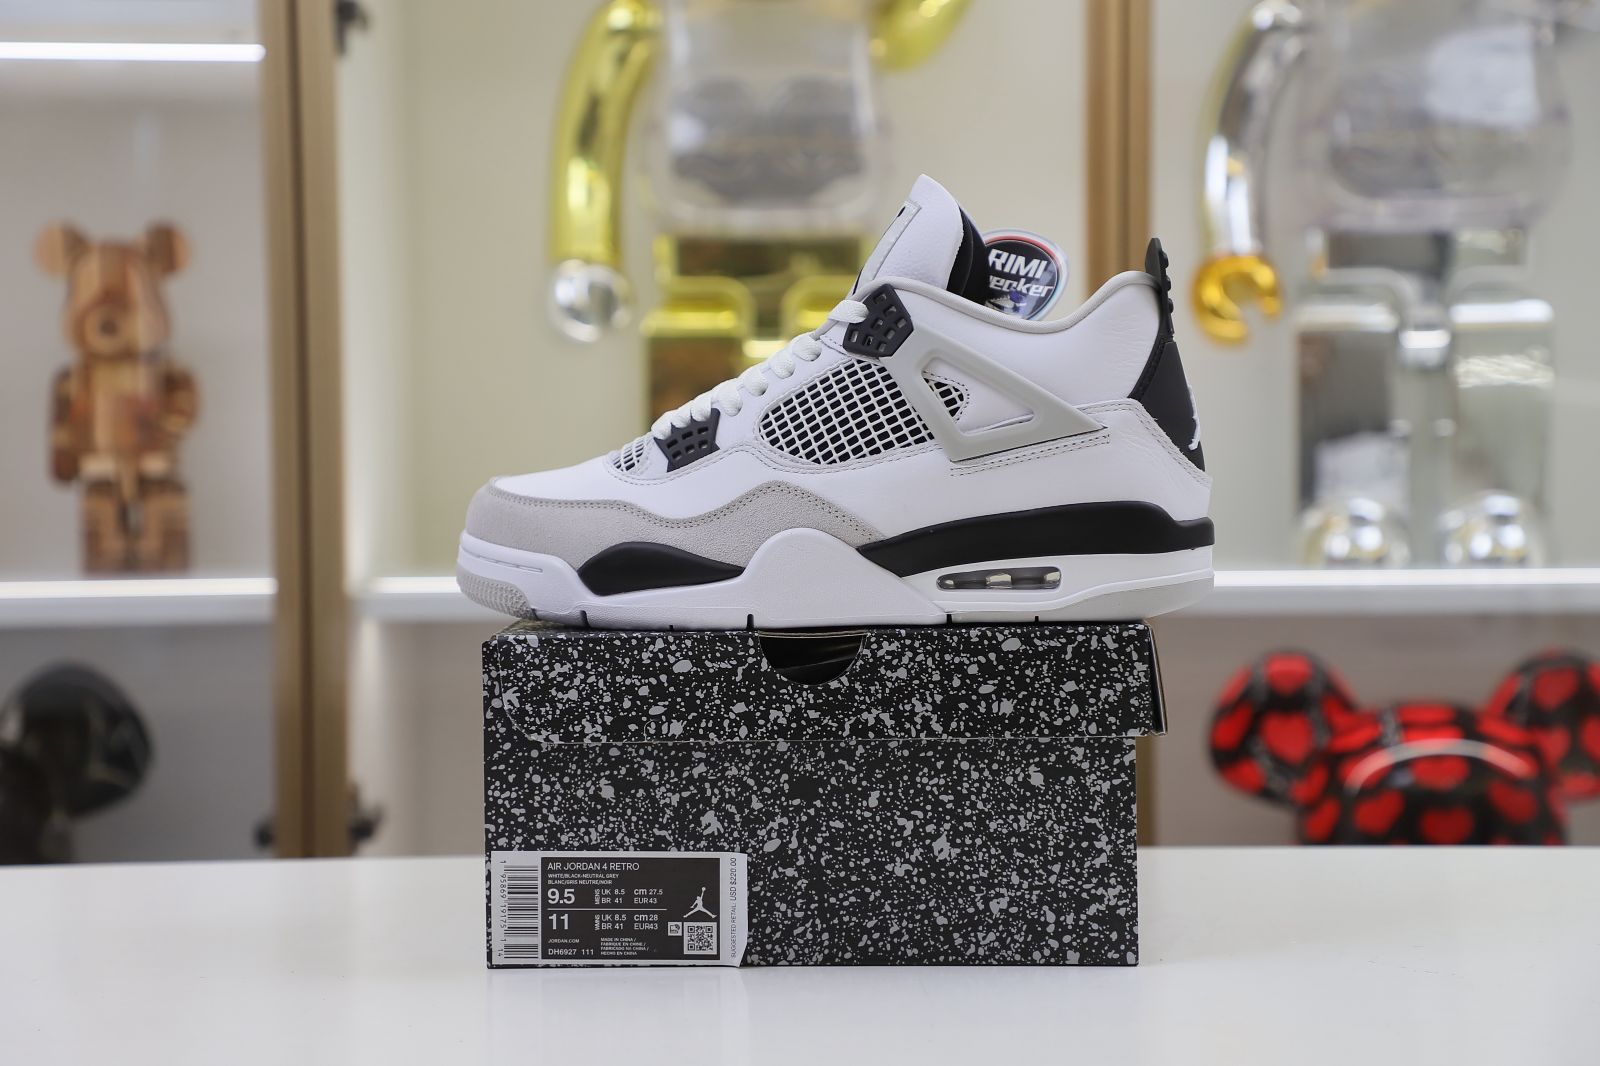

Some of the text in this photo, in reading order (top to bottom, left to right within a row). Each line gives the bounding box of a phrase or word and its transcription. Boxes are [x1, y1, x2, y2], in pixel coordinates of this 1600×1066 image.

[989, 274, 1055, 298] ecker
[547, 862, 640, 871] AIR JORDAN 4 RETRO
[729, 857, 737, 885] $220.00
[499, 874, 507, 899] 95869
[601, 888, 664, 896] UK 8.5 cm 27.5
[729, 886, 737, 901] USD
[547, 888, 576, 905] 9.5
[601, 897, 612, 905] BR
[614, 897, 623, 905] 41
[499, 904, 507, 929] 19175
[548, 913, 569, 930] 11
[601, 914, 613, 922] UK
[614, 914, 627, 922] 8.5
[601, 922, 613, 930] BR
[614, 922, 624, 930] 41
[548, 948, 594, 956] DH6927 111
